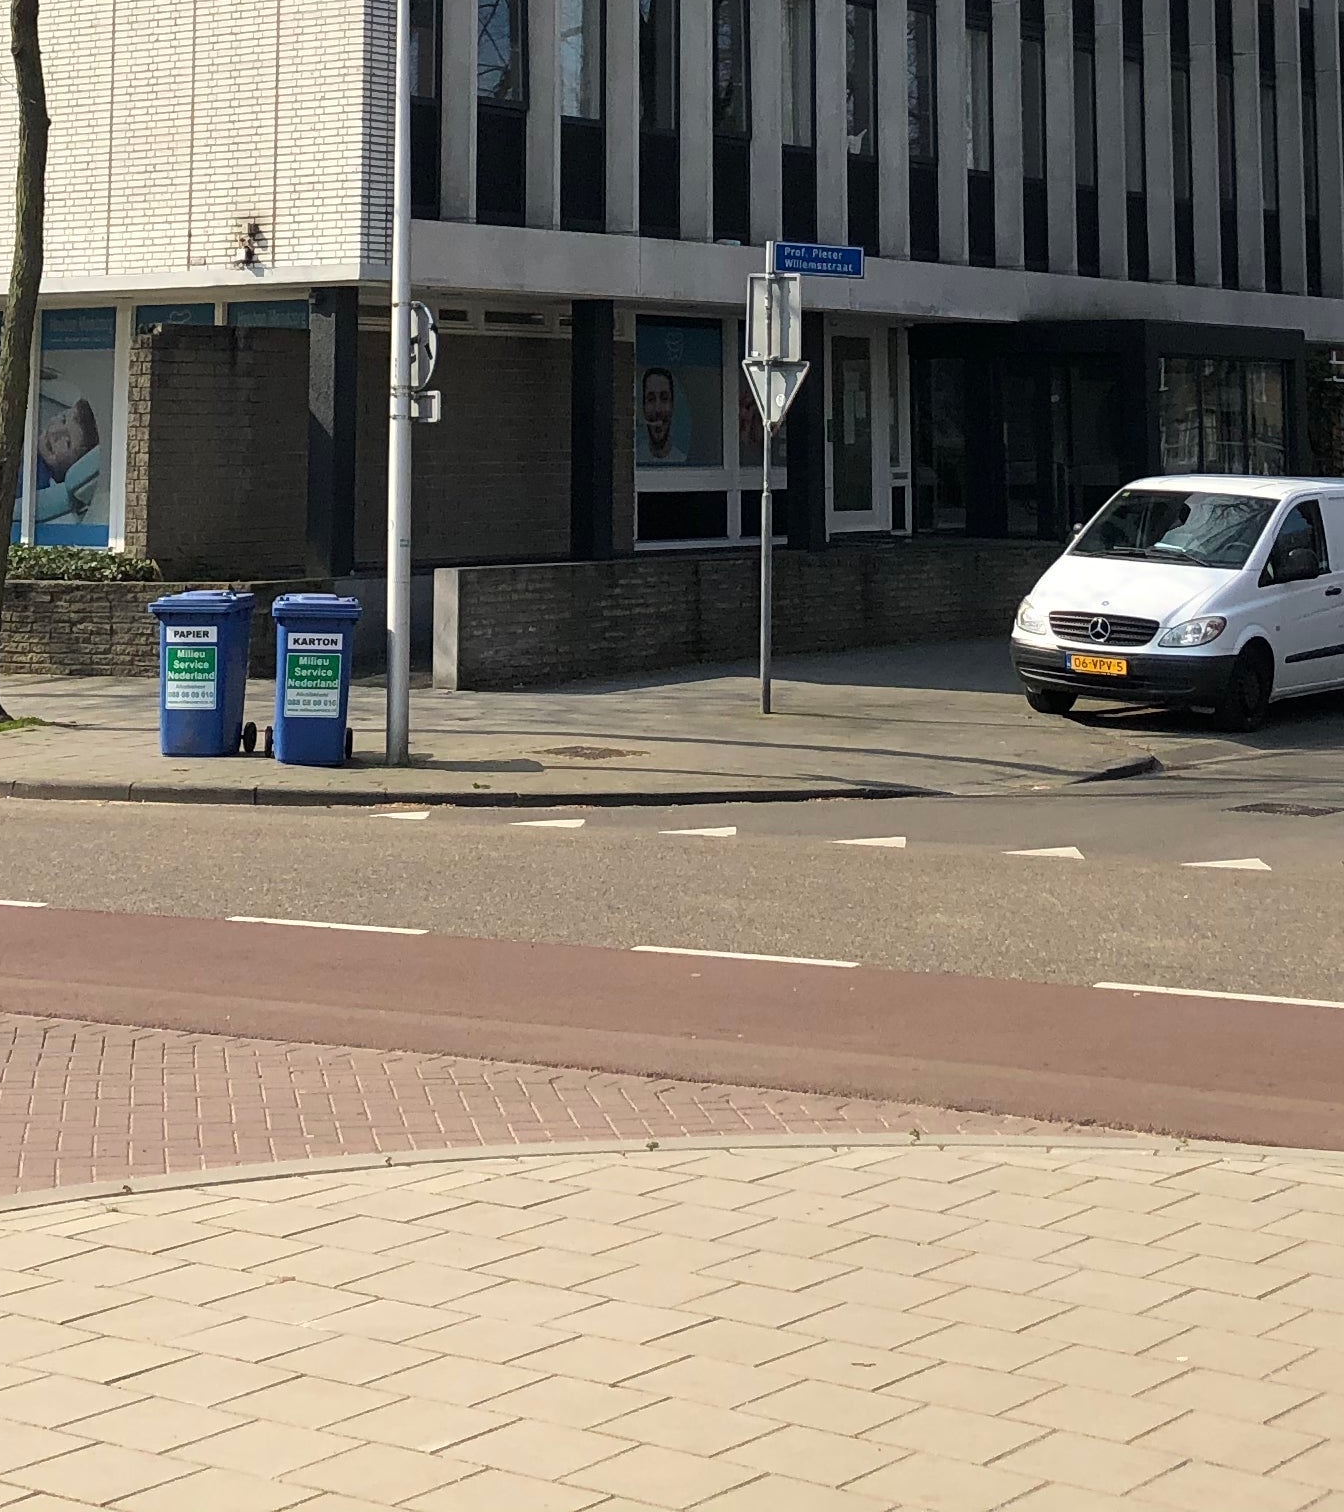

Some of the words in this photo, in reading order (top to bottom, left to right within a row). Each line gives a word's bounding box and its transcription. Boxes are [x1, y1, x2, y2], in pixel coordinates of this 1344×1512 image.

[784, 247, 808, 258] Prof.
[812, 248, 843, 260] Pieter
[784, 258, 853, 272] Willemsstraat
[173, 630, 210, 639] PAPIER
[292, 637, 338, 646] KARTON
[176, 649, 206, 658] Milieu
[173, 659, 210, 669] Service
[298, 656, 330, 666] Milieu
[167, 670, 215, 680] Nederland
[294, 667, 333, 676] Service
[287, 678, 339, 688] Nederland
